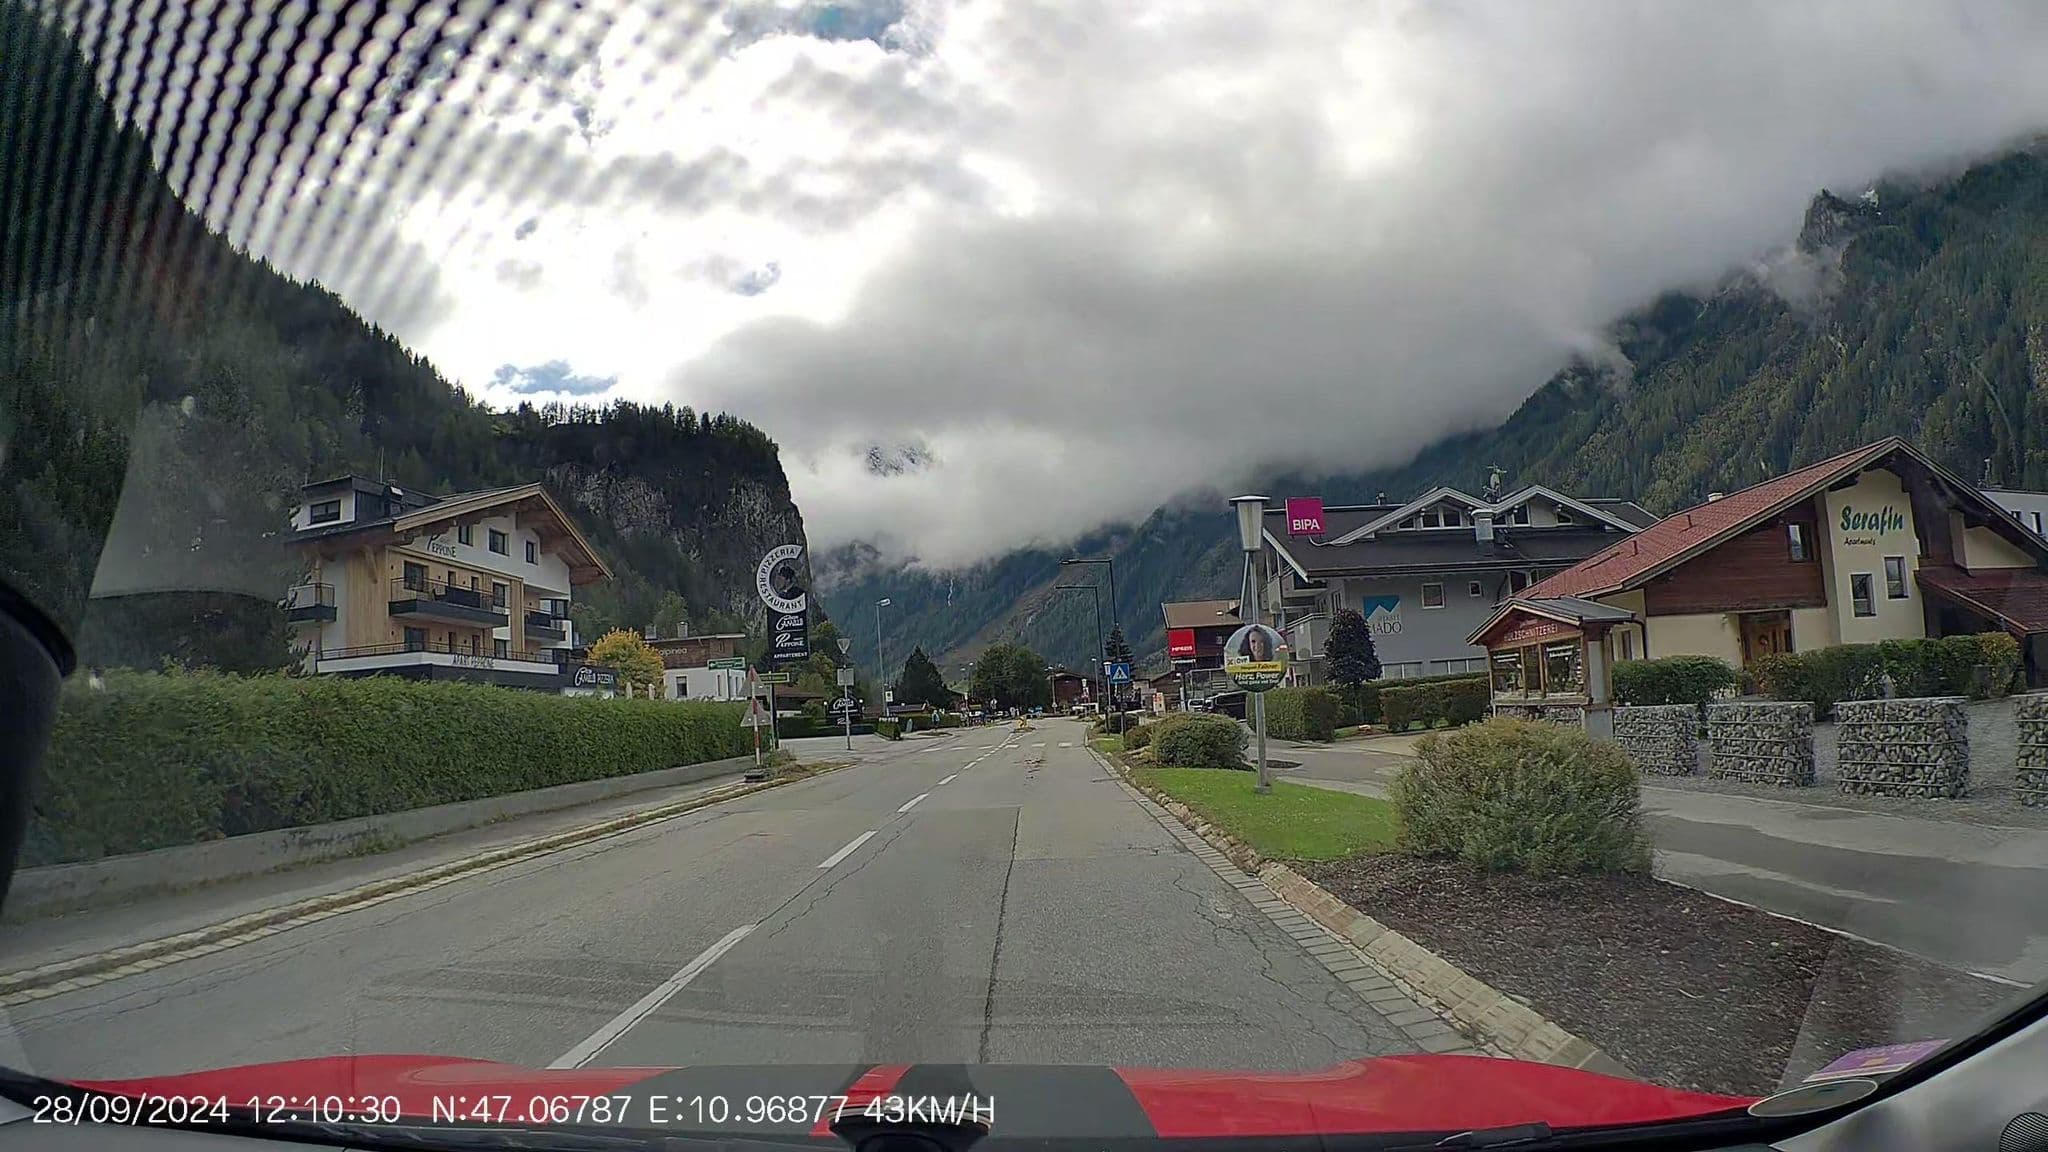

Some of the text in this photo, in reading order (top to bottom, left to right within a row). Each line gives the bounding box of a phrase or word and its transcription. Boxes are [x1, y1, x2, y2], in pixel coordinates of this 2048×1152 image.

[1292, 518, 1321, 531] BIPA
[1840, 505, 1903, 536] Serafin
[761, 548, 795, 574] PIZZERIA
[759, 577, 803, 609] RESTAURANT
[1234, 672, 1280, 681] Herz Power
